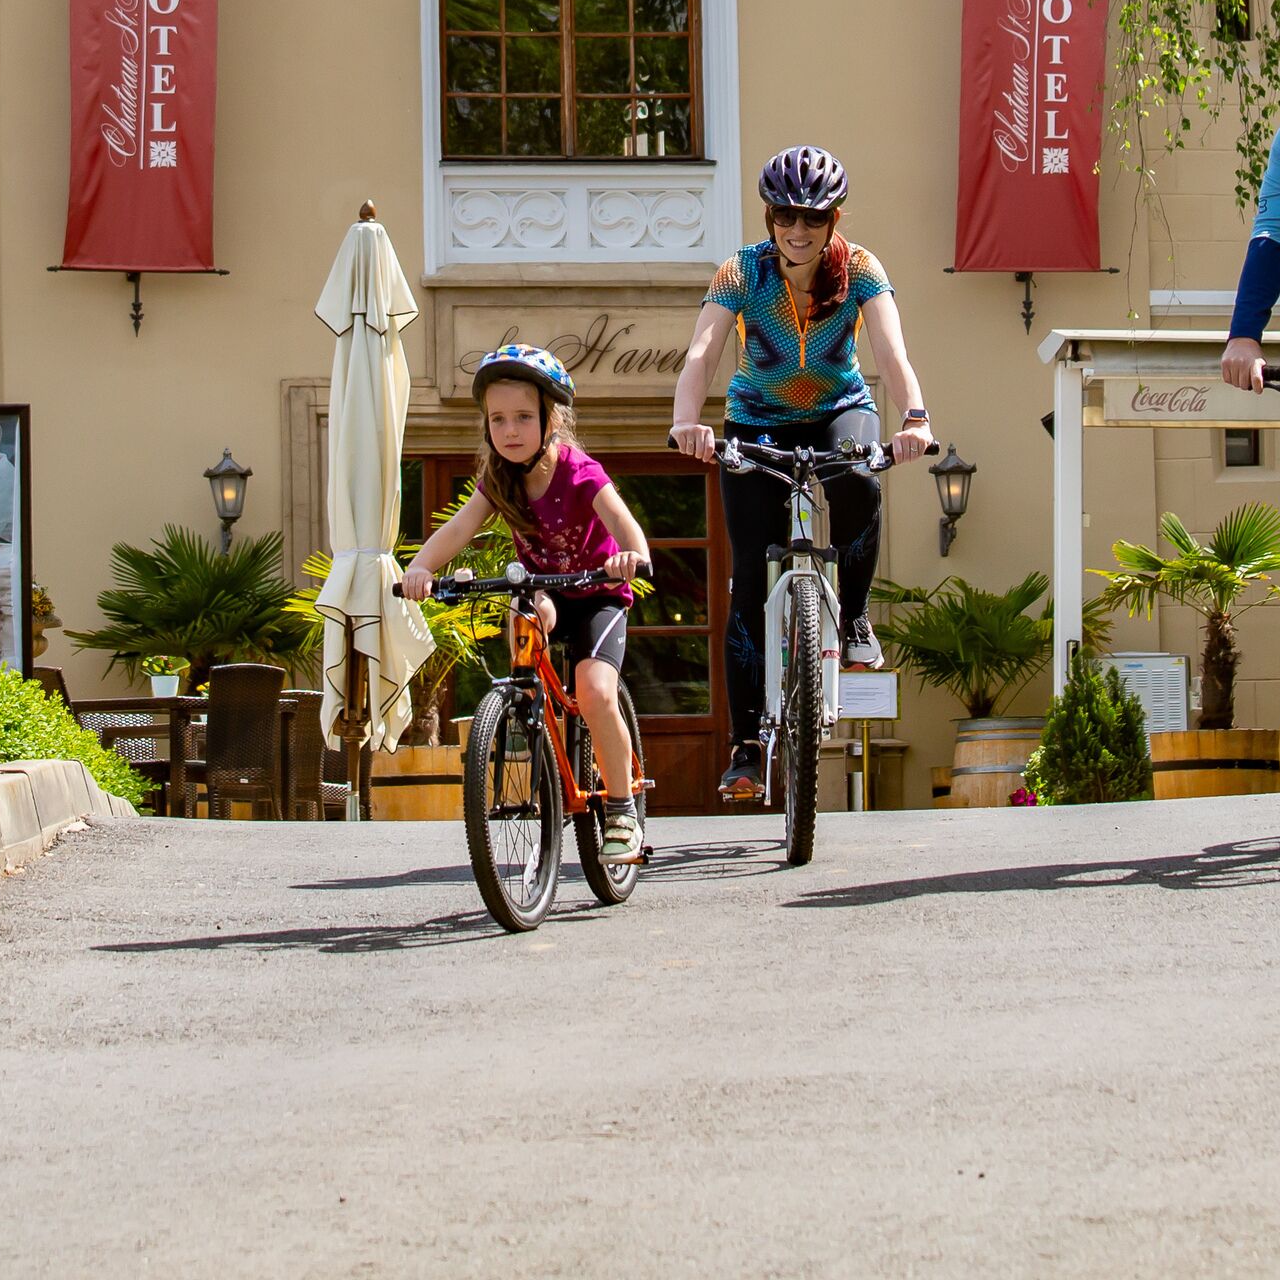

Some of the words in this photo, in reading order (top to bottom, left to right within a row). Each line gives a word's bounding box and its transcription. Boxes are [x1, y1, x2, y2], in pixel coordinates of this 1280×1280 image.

[104, 7, 139, 55] St.
[997, 14, 1031, 61] St.
[101, 56, 138, 167] Chateau
[993, 63, 1029, 172] Chateau
[1131, 385, 1211, 412] Coca-Cola
